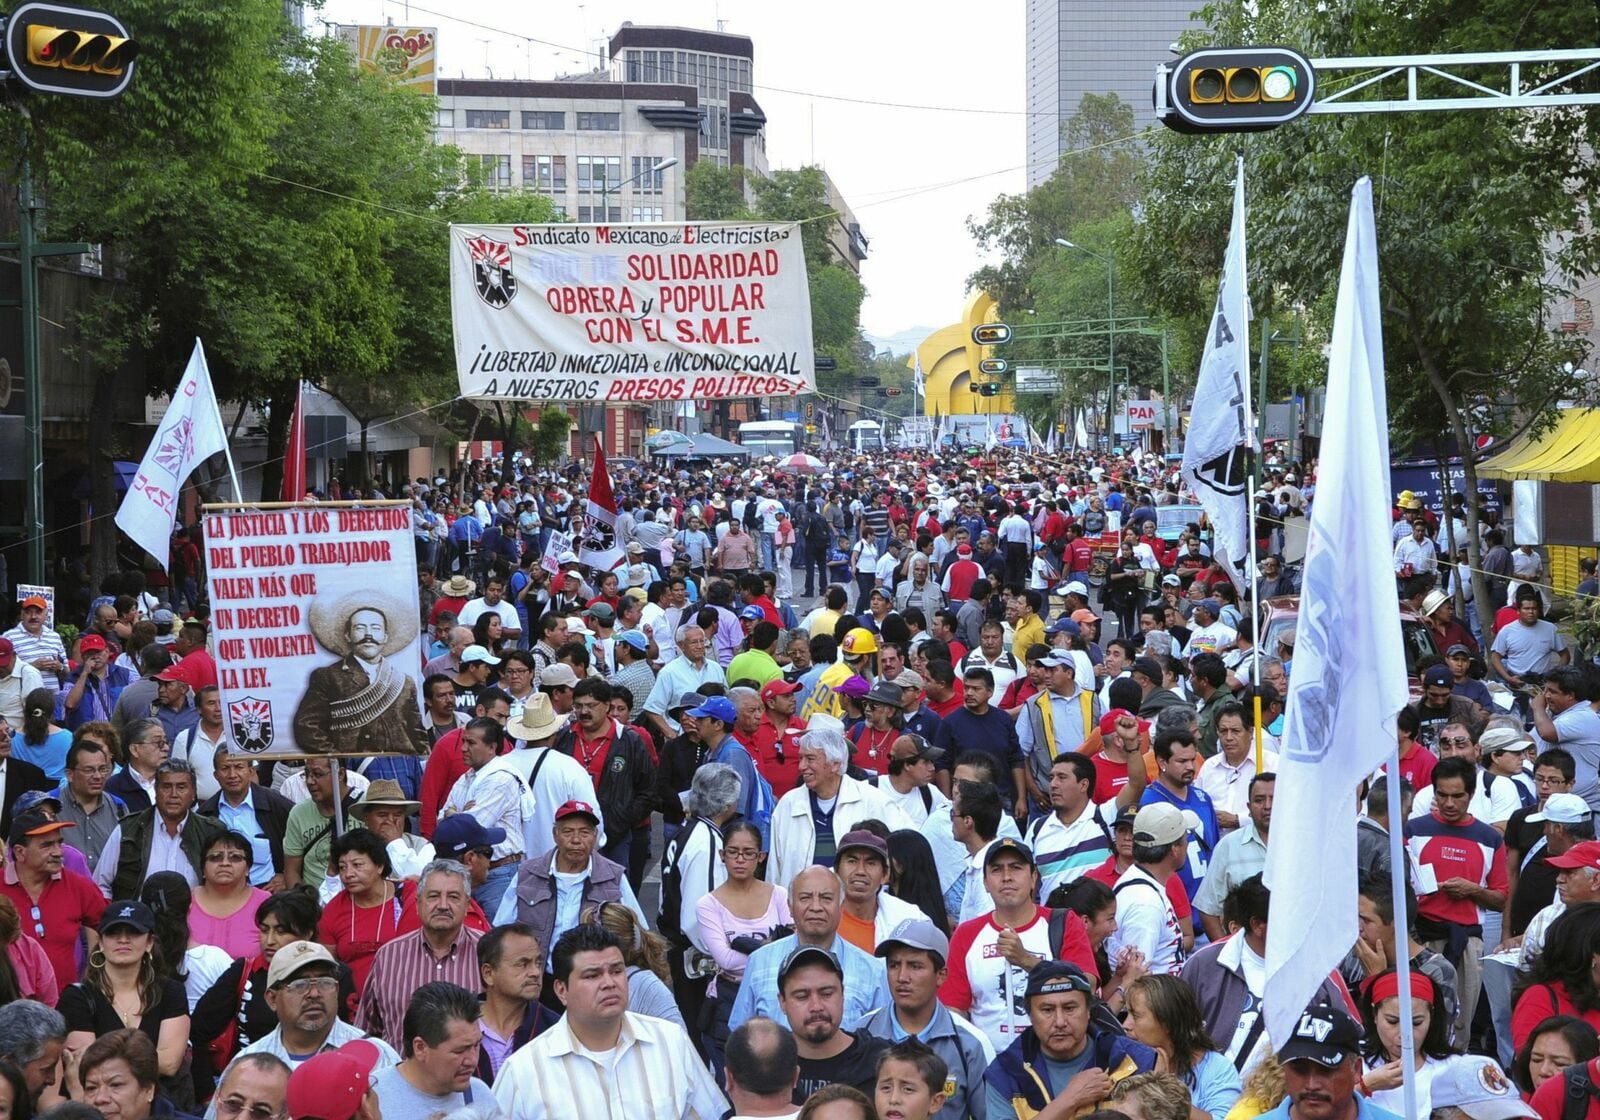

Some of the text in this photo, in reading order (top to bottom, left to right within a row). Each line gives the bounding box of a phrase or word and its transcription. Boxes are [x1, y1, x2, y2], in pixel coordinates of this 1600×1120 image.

[513, 225, 790, 246] Sindicato Mexicano de Electricistas
[628, 249, 778, 281] SOLIDARIDAD
[547, 283, 765, 321] OBRERA y POPULAR
[585, 317, 759, 344] CON EL S.M.E.
[470, 344, 800, 375] ¡LIBERTAD INMEDIATA e INCONDICIONAL
[483, 378, 498, 396] A
[505, 379, 599, 399] NUESTROS
[605, 378, 685, 399] PRESOS
[1430, 470, 1465, 480] TOTAS
[207, 507, 409, 540] LA JUSTICIA Y LOS DERECHOS
[211, 540, 391, 569] DEL PUEBLO TRABAJADOR
[214, 572, 316, 600] VALEN MÁS QUE
[216, 605, 299, 630] UN DECRETO
[219, 634, 316, 661] QUE VIOLENTA
[222, 667, 271, 689] LA LEY.
[1297, 1014, 1333, 1042] LV
